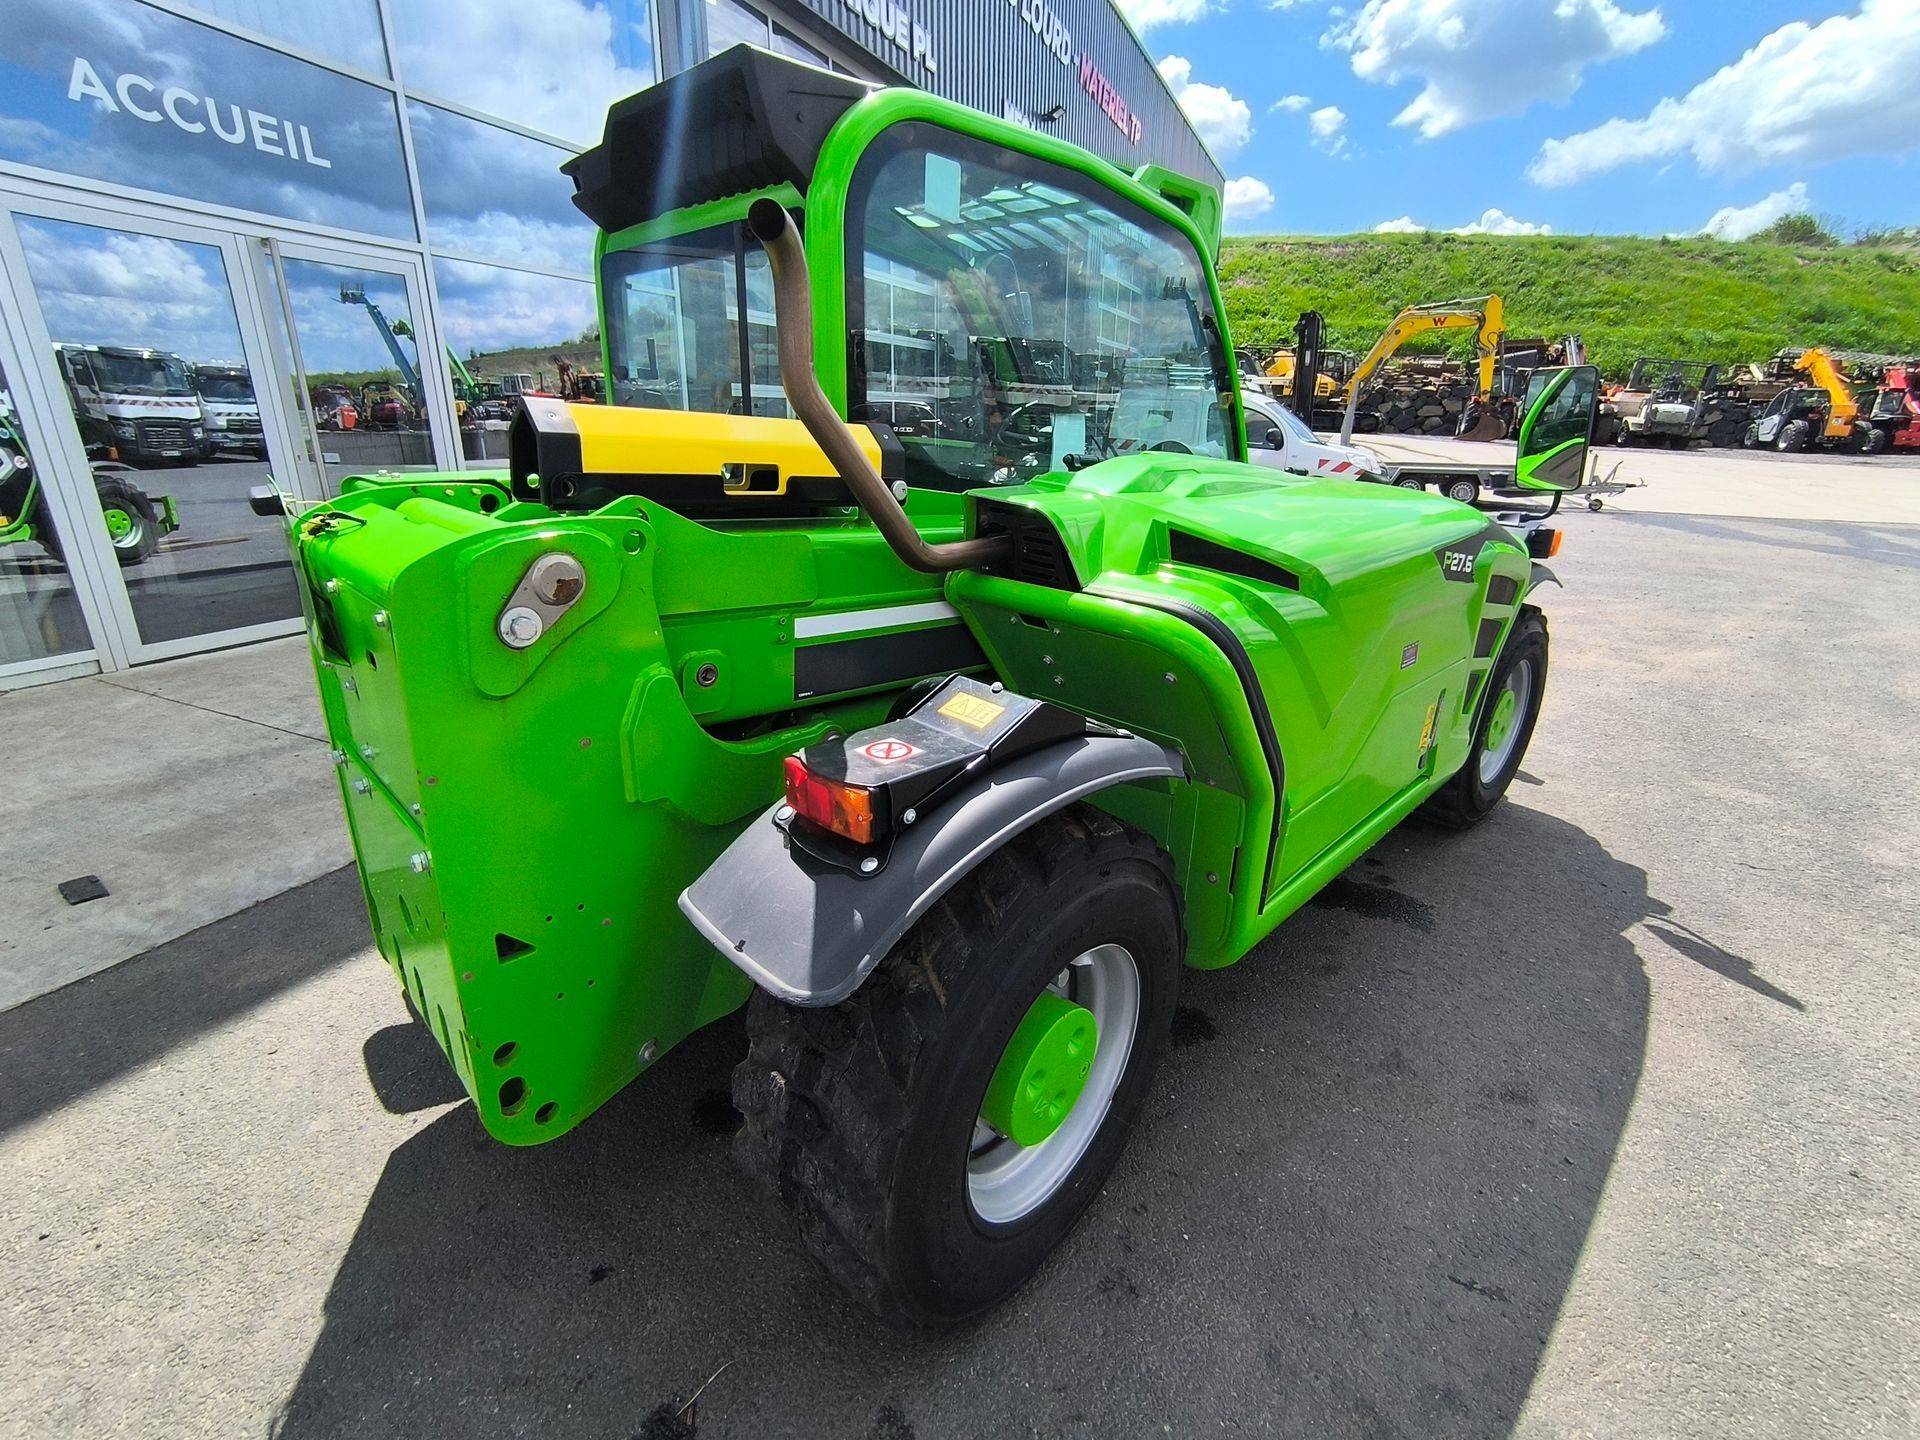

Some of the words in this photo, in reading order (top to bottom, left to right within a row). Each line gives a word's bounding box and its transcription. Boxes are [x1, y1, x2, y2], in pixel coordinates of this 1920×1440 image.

[913, 21, 937, 73] PL
[68, 56, 332, 169] ACCUEIL
[1080, 52, 1129, 136] MATERIEL
[1130, 112, 1142, 147] TP
[1443, 551, 1473, 573] P27.6
